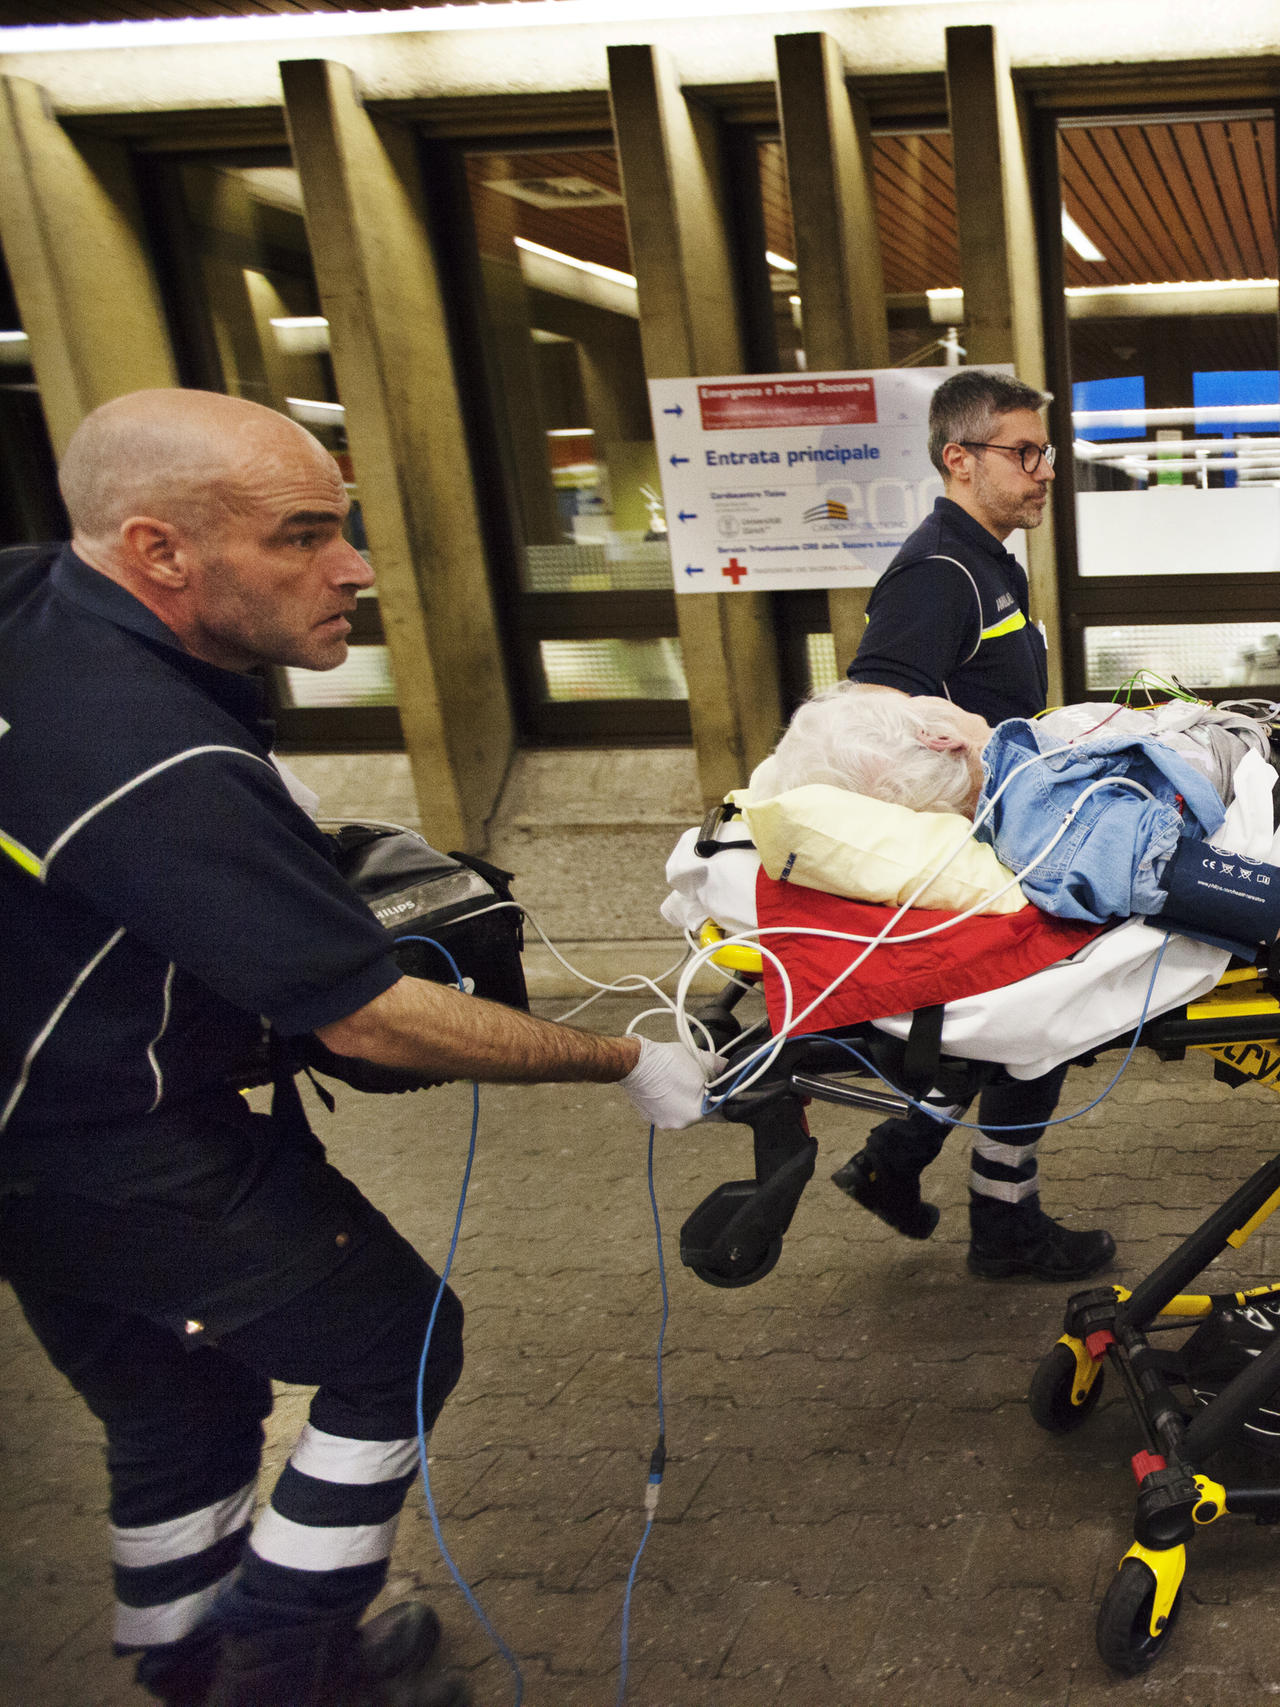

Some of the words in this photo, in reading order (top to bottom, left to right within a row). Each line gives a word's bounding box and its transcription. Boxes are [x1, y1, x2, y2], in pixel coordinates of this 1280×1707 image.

[774, 384, 815, 395] Pronto
[816, 381, 870, 394] Soccorso
[705, 450, 781, 466] Entrata
[787, 443, 881, 467] principale
[1202, 858, 1217, 870] CE
[374, 900, 416, 920] HILIPS
